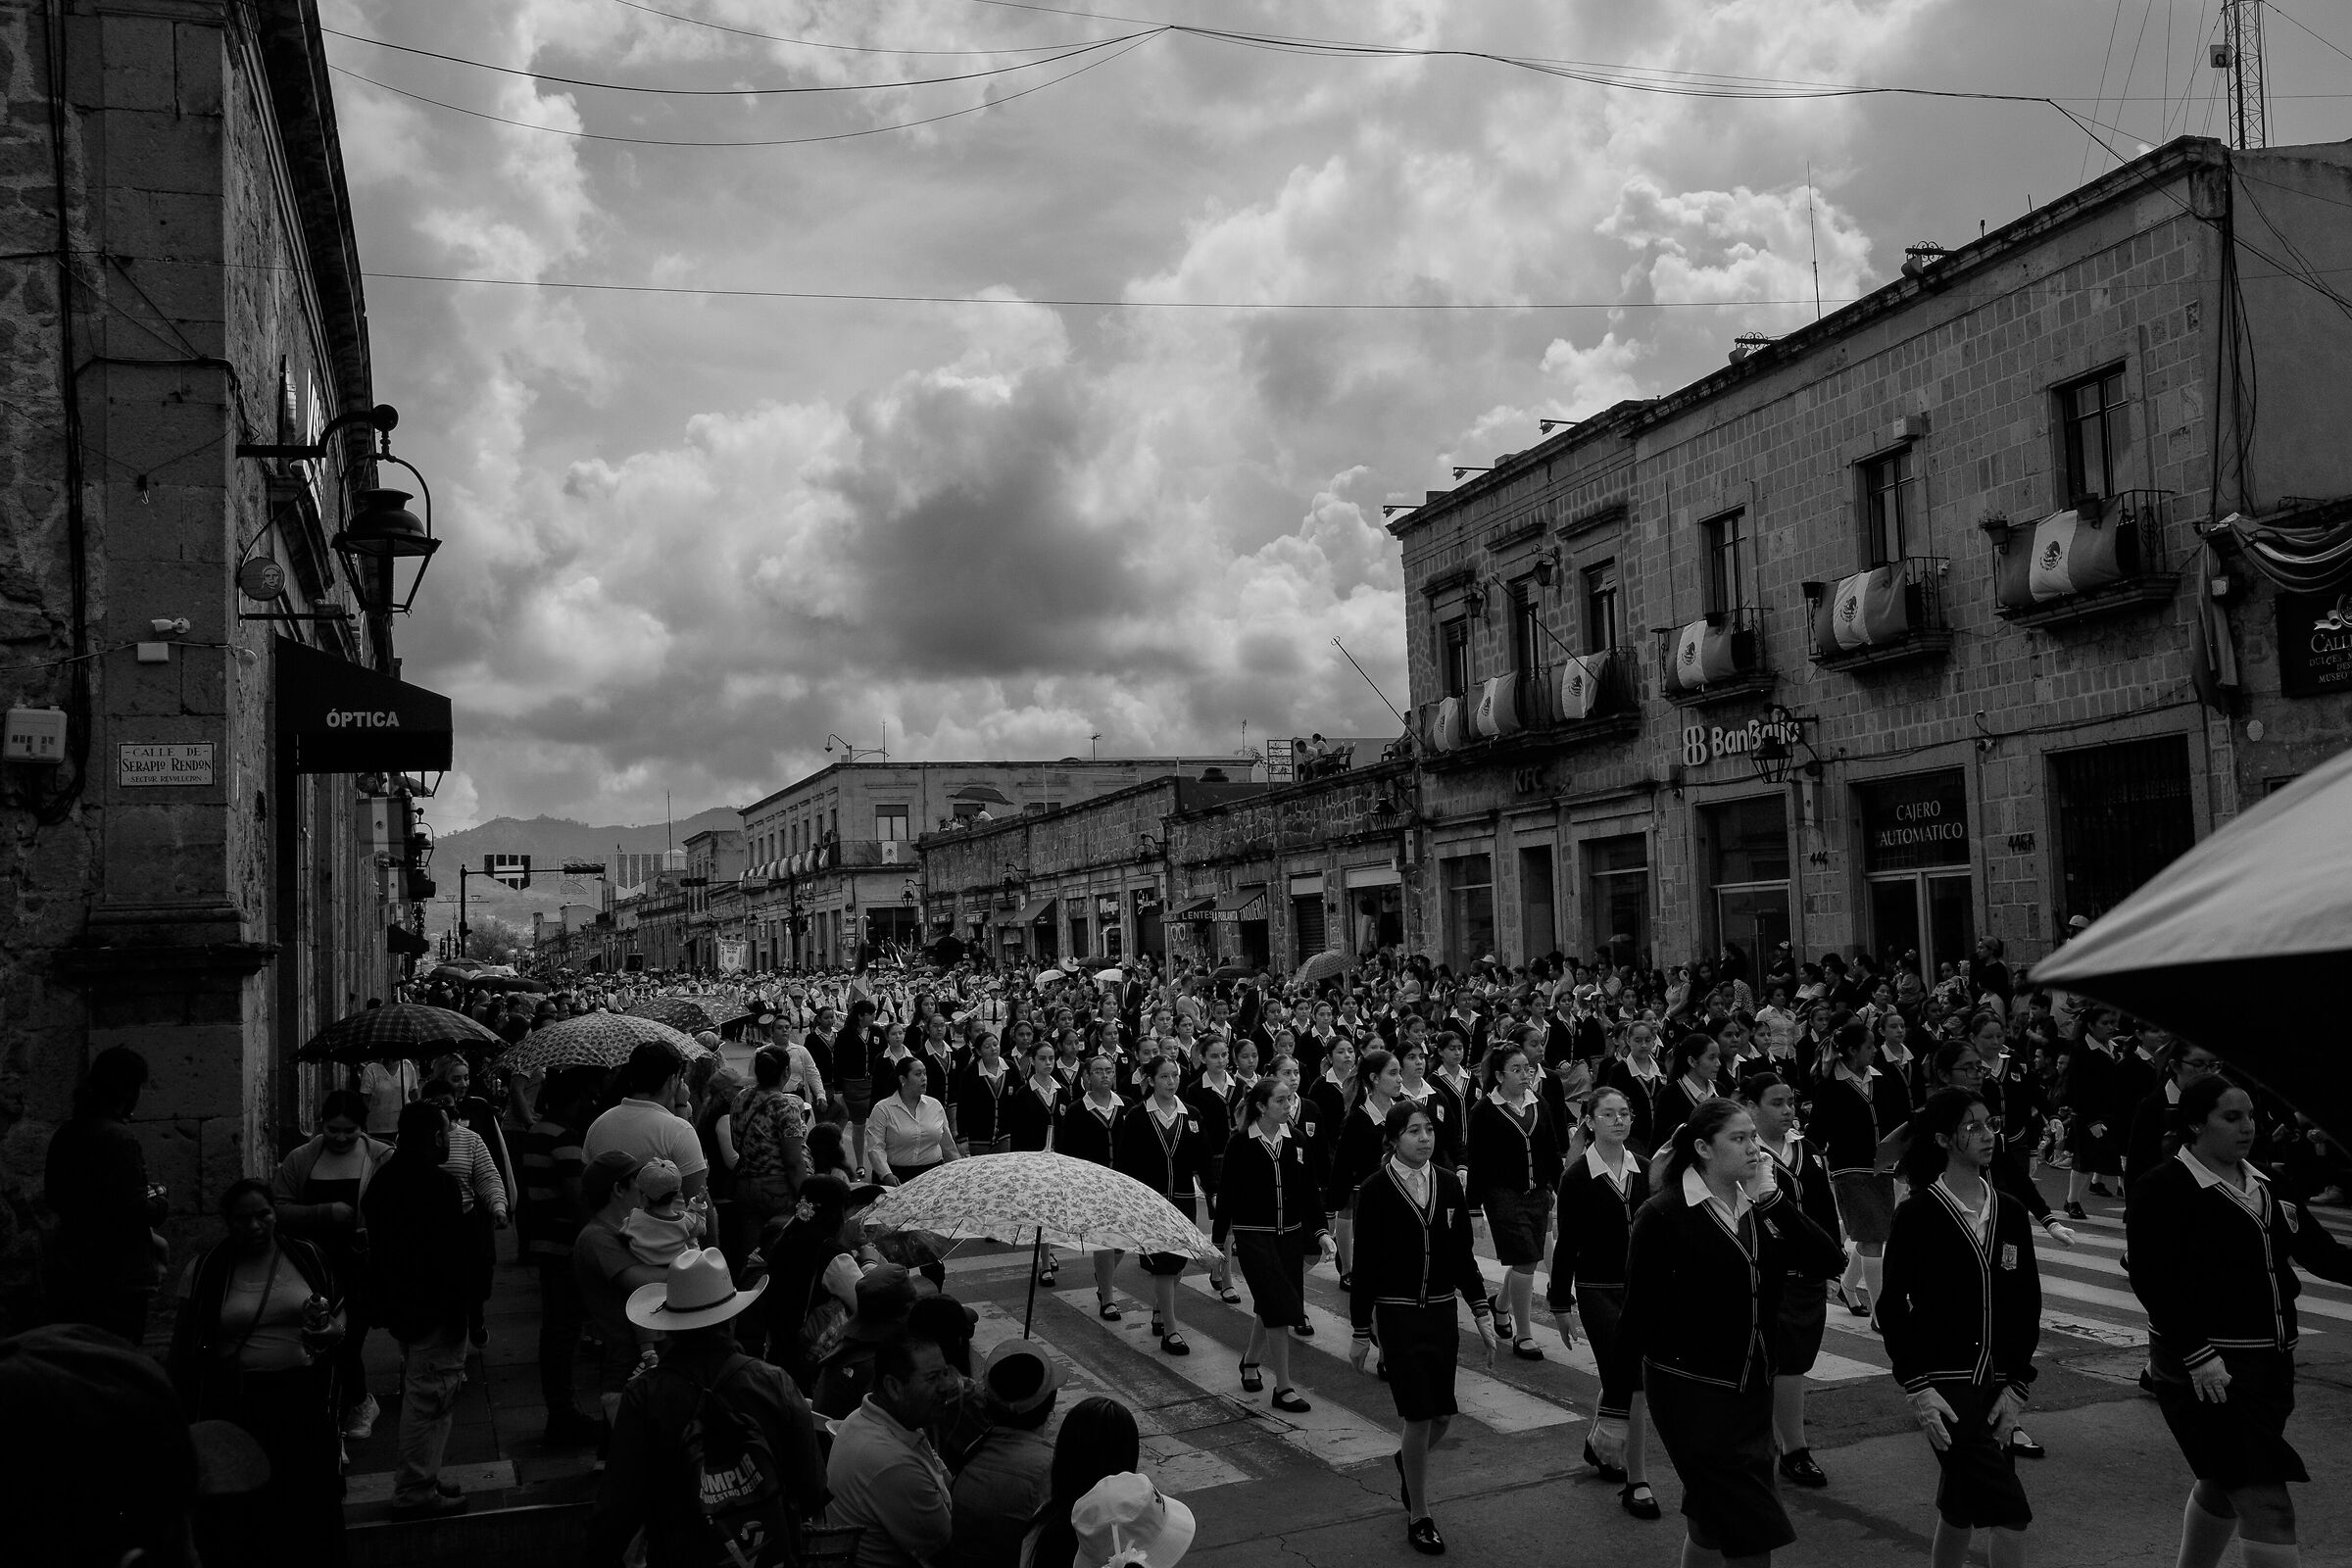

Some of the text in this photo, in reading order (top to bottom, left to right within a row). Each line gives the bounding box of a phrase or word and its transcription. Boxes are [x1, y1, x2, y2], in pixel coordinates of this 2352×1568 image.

[2319, 671, 2348, 683] MUSEO
[326, 708, 400, 727] ÓPTICA
[132, 747, 202, 757] CALLE DE
[160, 774, 203, 783] REVOLUCION
[1896, 800, 1941, 822] CAJERO
[1880, 821, 1963, 847] AUTOMATICO
[2008, 833, 2035, 853] 446A
[1810, 851, 1828, 866] 446
[1181, 910, 1213, 920] LENTES
